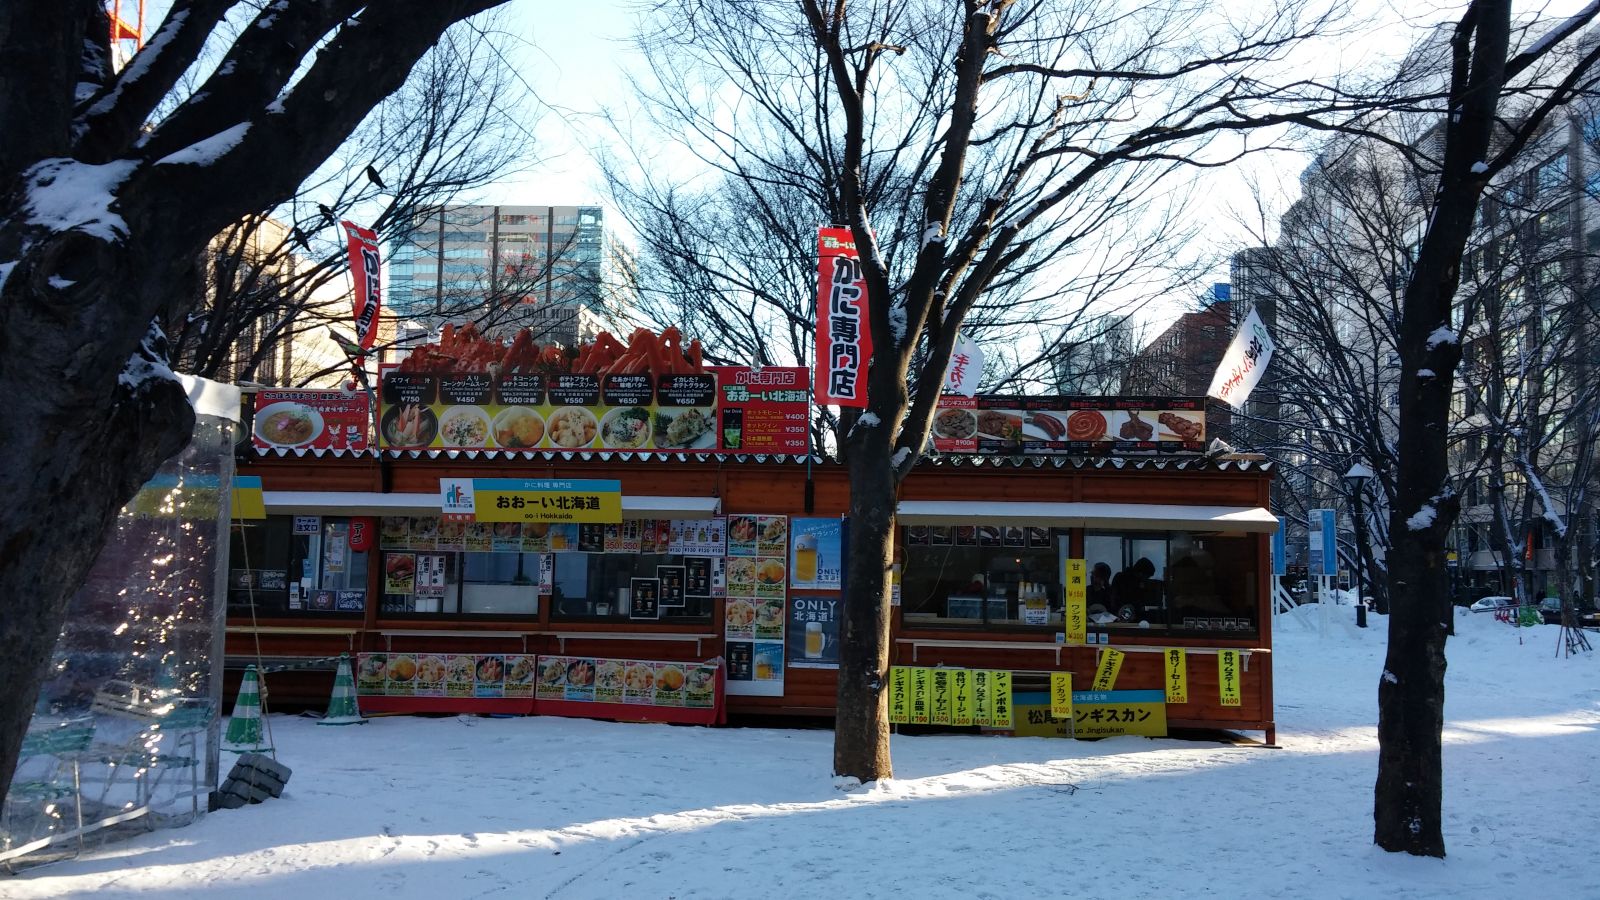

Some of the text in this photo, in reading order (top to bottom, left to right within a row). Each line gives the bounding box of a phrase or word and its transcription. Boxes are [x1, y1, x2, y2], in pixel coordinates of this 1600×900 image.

[828, 254, 862, 399] かに専門店
[735, 371, 795, 384] かに専門店
[726, 390, 808, 402] おおーい北海道
[496, 496, 600, 510] おおーい北海道
[540, 512, 572, 520] Hokkaido
[1072, 563, 1080, 584] 甘酒
[794, 600, 837, 618] ONLY
[1072, 605, 1080, 630] ワンカップ
[1170, 650, 1180, 691] 骨付ソーセージ
[996, 672, 1006, 714] ジャンボ串
[1056, 677, 1065, 704] ワンカップ
[1028, 708, 1151, 725] 松尾ンギスカン
[1086, 727, 1125, 735] Jingisukan
